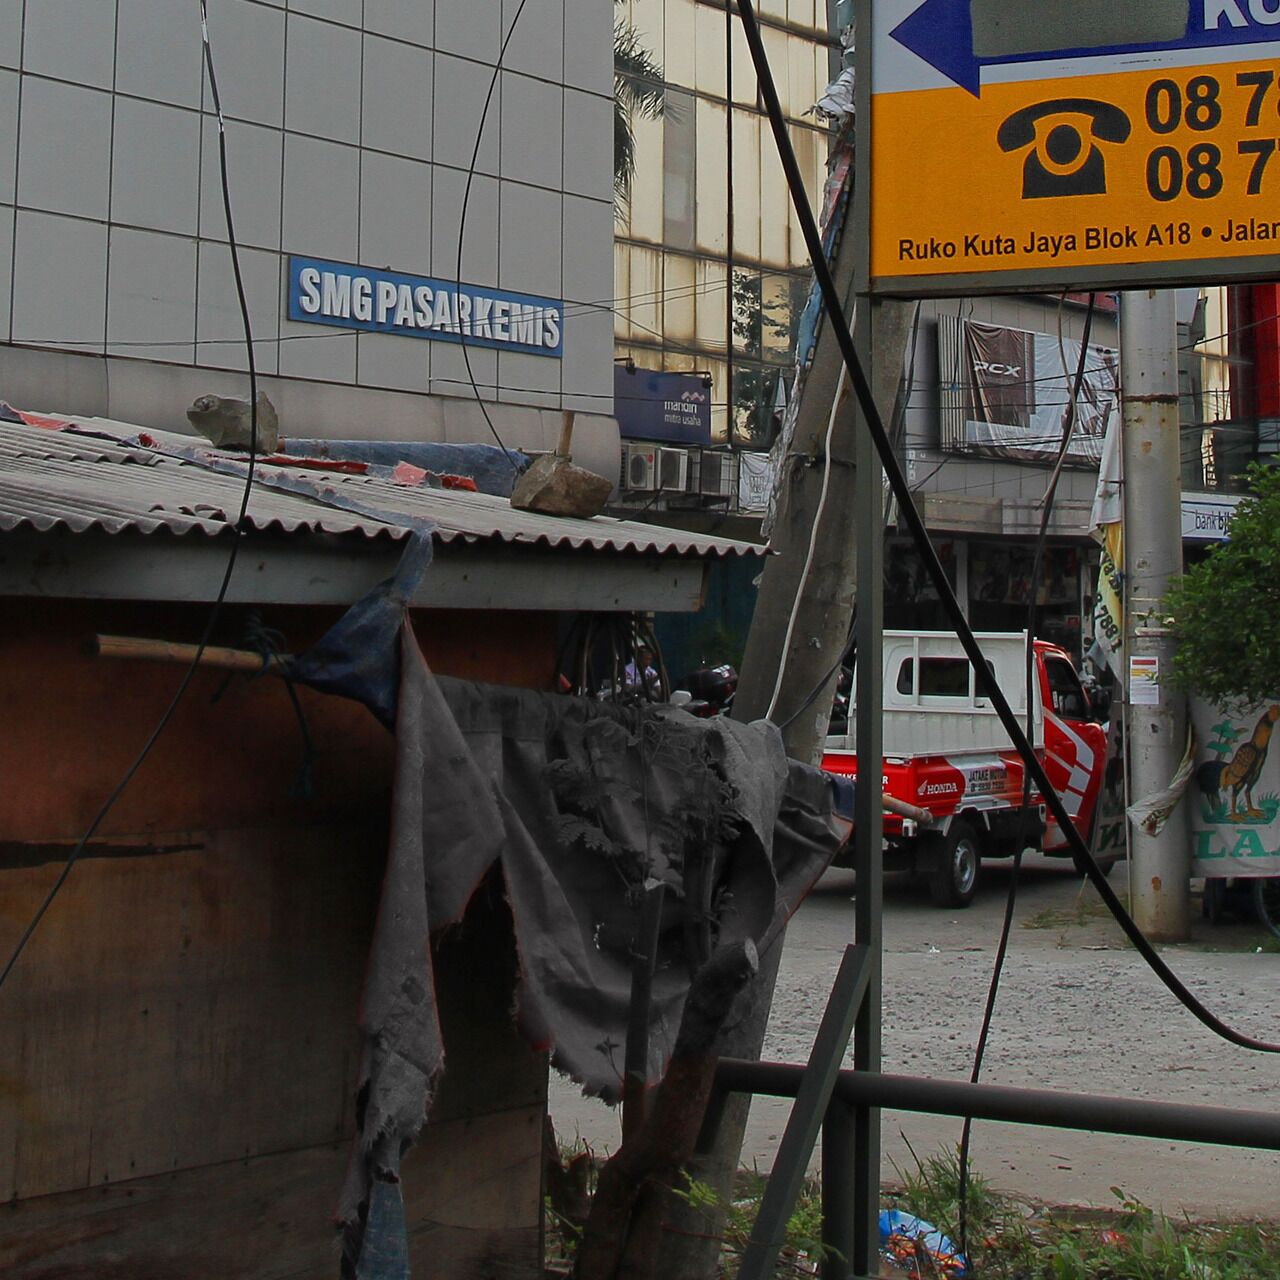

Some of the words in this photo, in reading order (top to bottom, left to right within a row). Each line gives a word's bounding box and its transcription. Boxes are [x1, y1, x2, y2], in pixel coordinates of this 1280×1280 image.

[1145, 75, 1222, 134] 08
[1146, 142, 1224, 202] 08
[898, 235, 957, 260] Ruko
[963, 231, 1017, 257] Kuta
[1022, 230, 1077, 258] Jaya
[1084, 224, 1139, 250] Blok
[1144, 221, 1192, 247] A18
[299, 267, 372, 322] SMG
[974, 360, 1022, 378] PCX
[663, 399, 698, 414] mandiri
[1195, 509, 1217, 530] bank
[927, 782, 958, 795] HONDA
